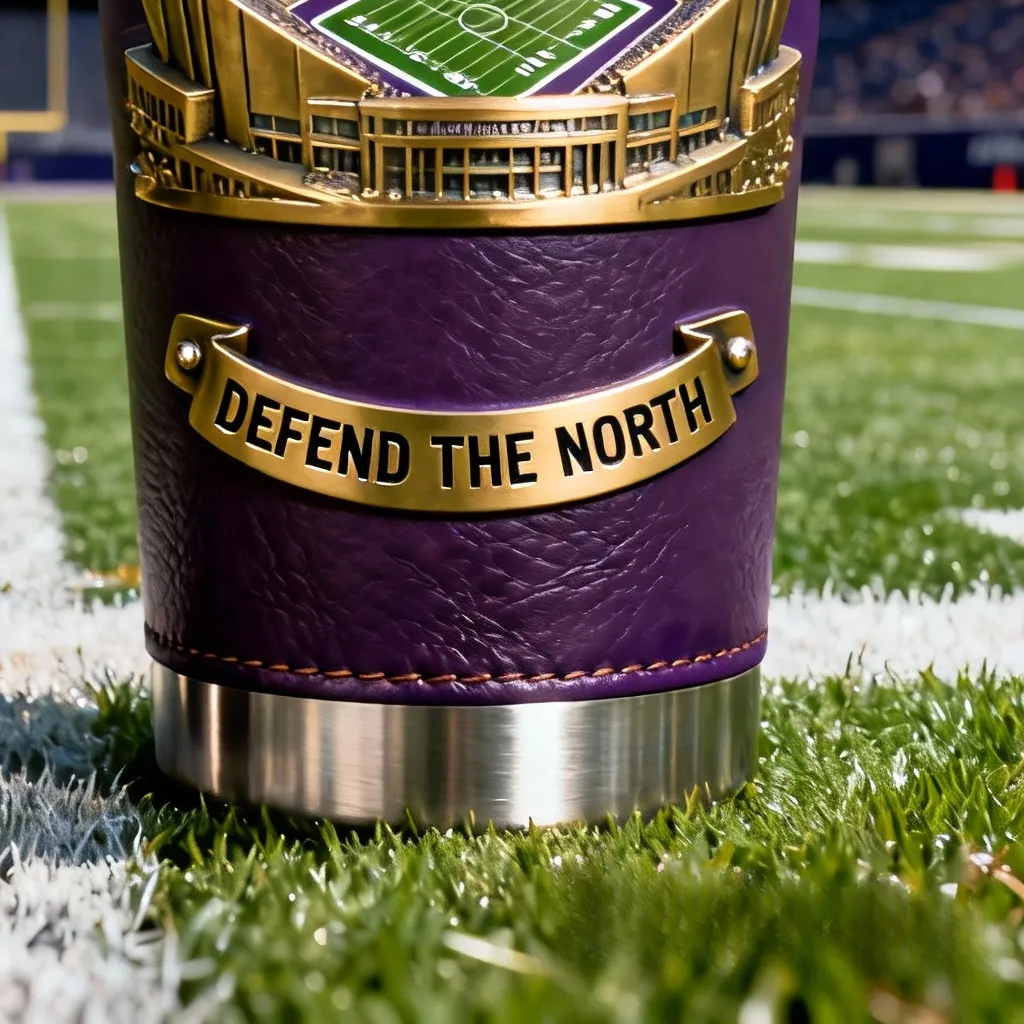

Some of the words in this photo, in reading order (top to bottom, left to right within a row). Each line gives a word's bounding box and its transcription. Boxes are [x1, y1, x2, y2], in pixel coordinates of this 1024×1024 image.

[213, 378, 410, 486] DEFEND
[430, 432, 538, 490] THE
[555, 376, 713, 478] NORTH
